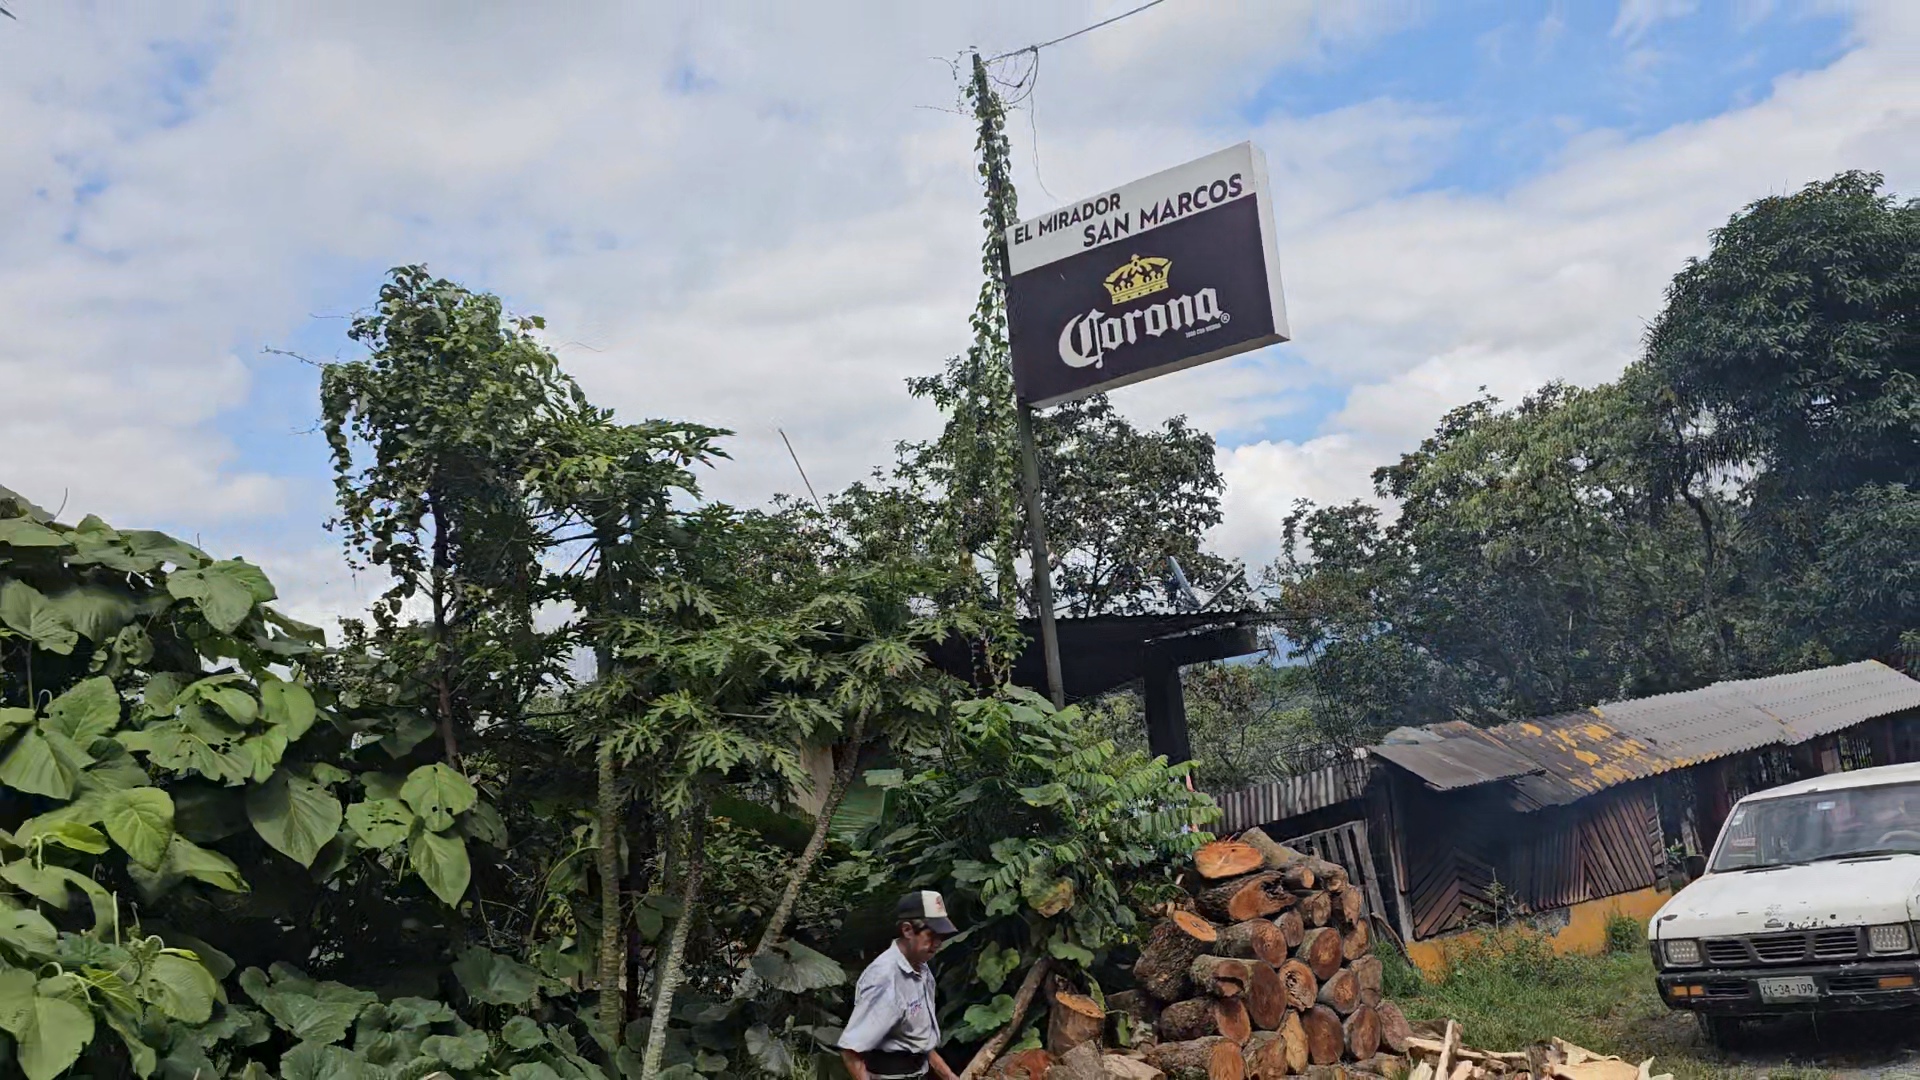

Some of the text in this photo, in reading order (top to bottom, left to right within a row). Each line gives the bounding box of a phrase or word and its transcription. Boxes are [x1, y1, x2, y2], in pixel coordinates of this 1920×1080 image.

[1014, 193, 1121, 245] EL MIRADOR
[1083, 173, 1243, 248] SAN MARCOS
[1058, 287, 1224, 369] Corona
